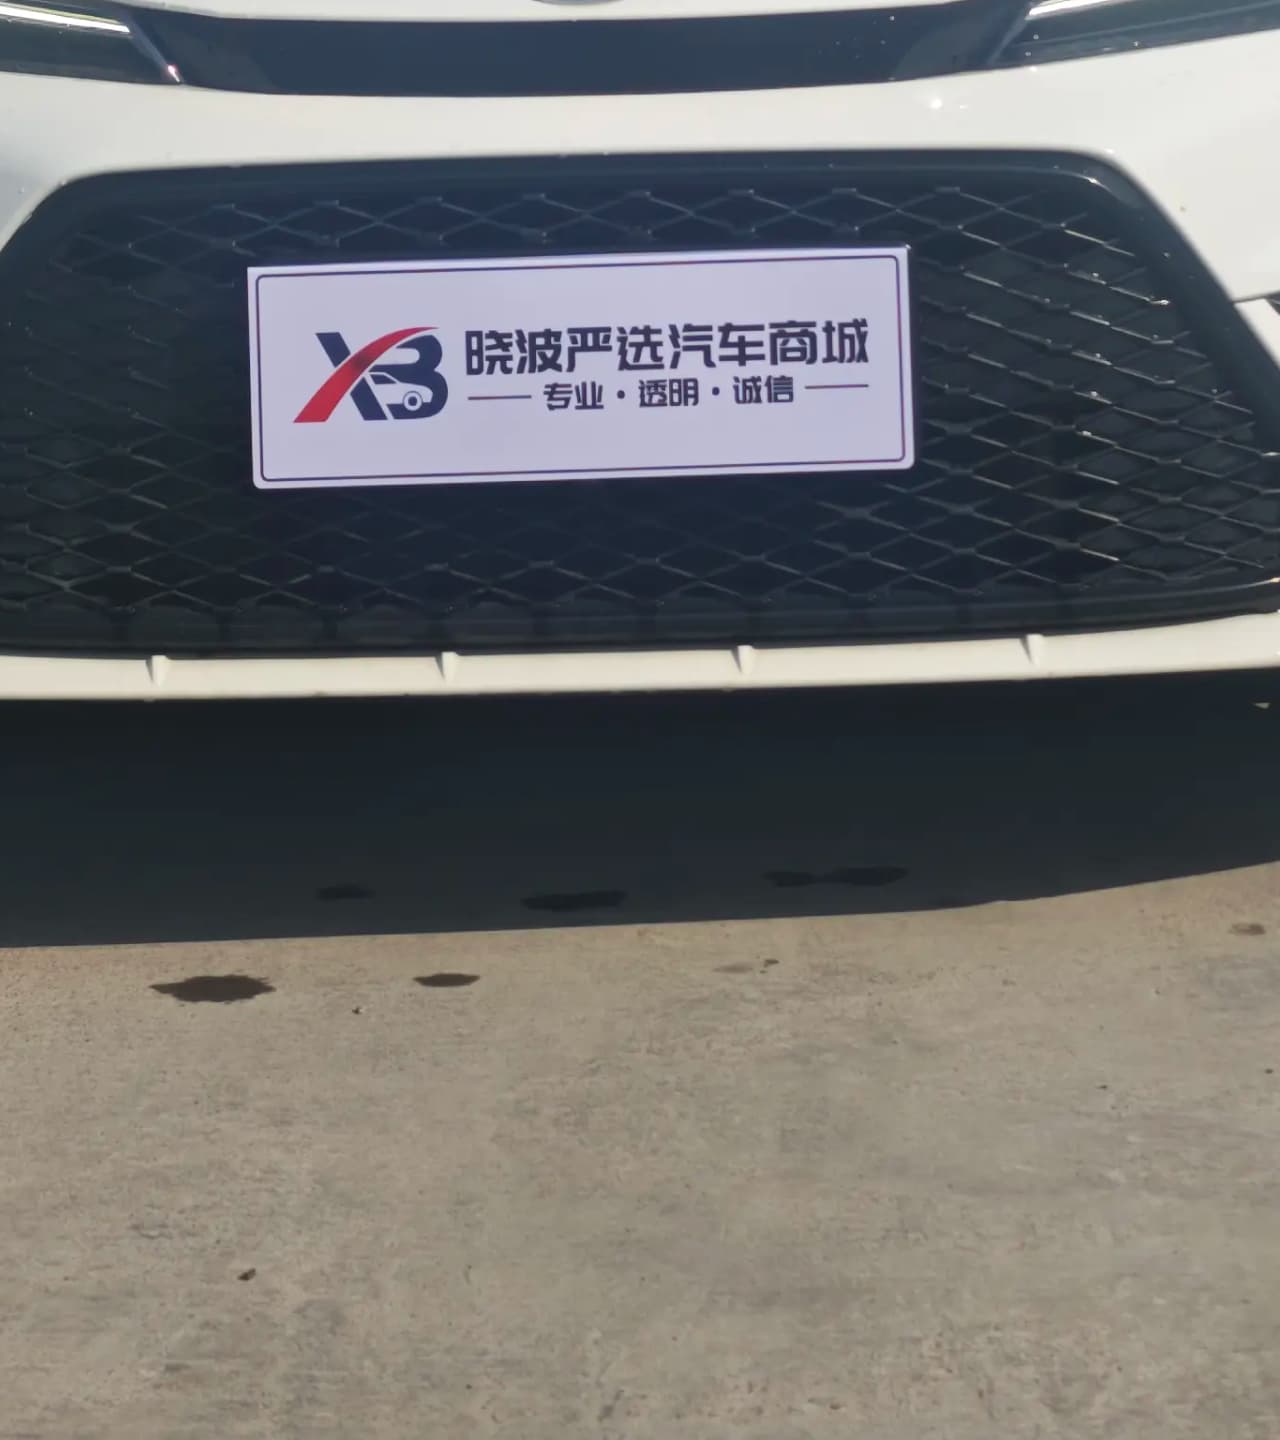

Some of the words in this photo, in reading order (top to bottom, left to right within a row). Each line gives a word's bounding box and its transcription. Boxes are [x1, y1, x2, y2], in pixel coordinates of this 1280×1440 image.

[465, 318, 869, 375] 晓波严选汽车商城
